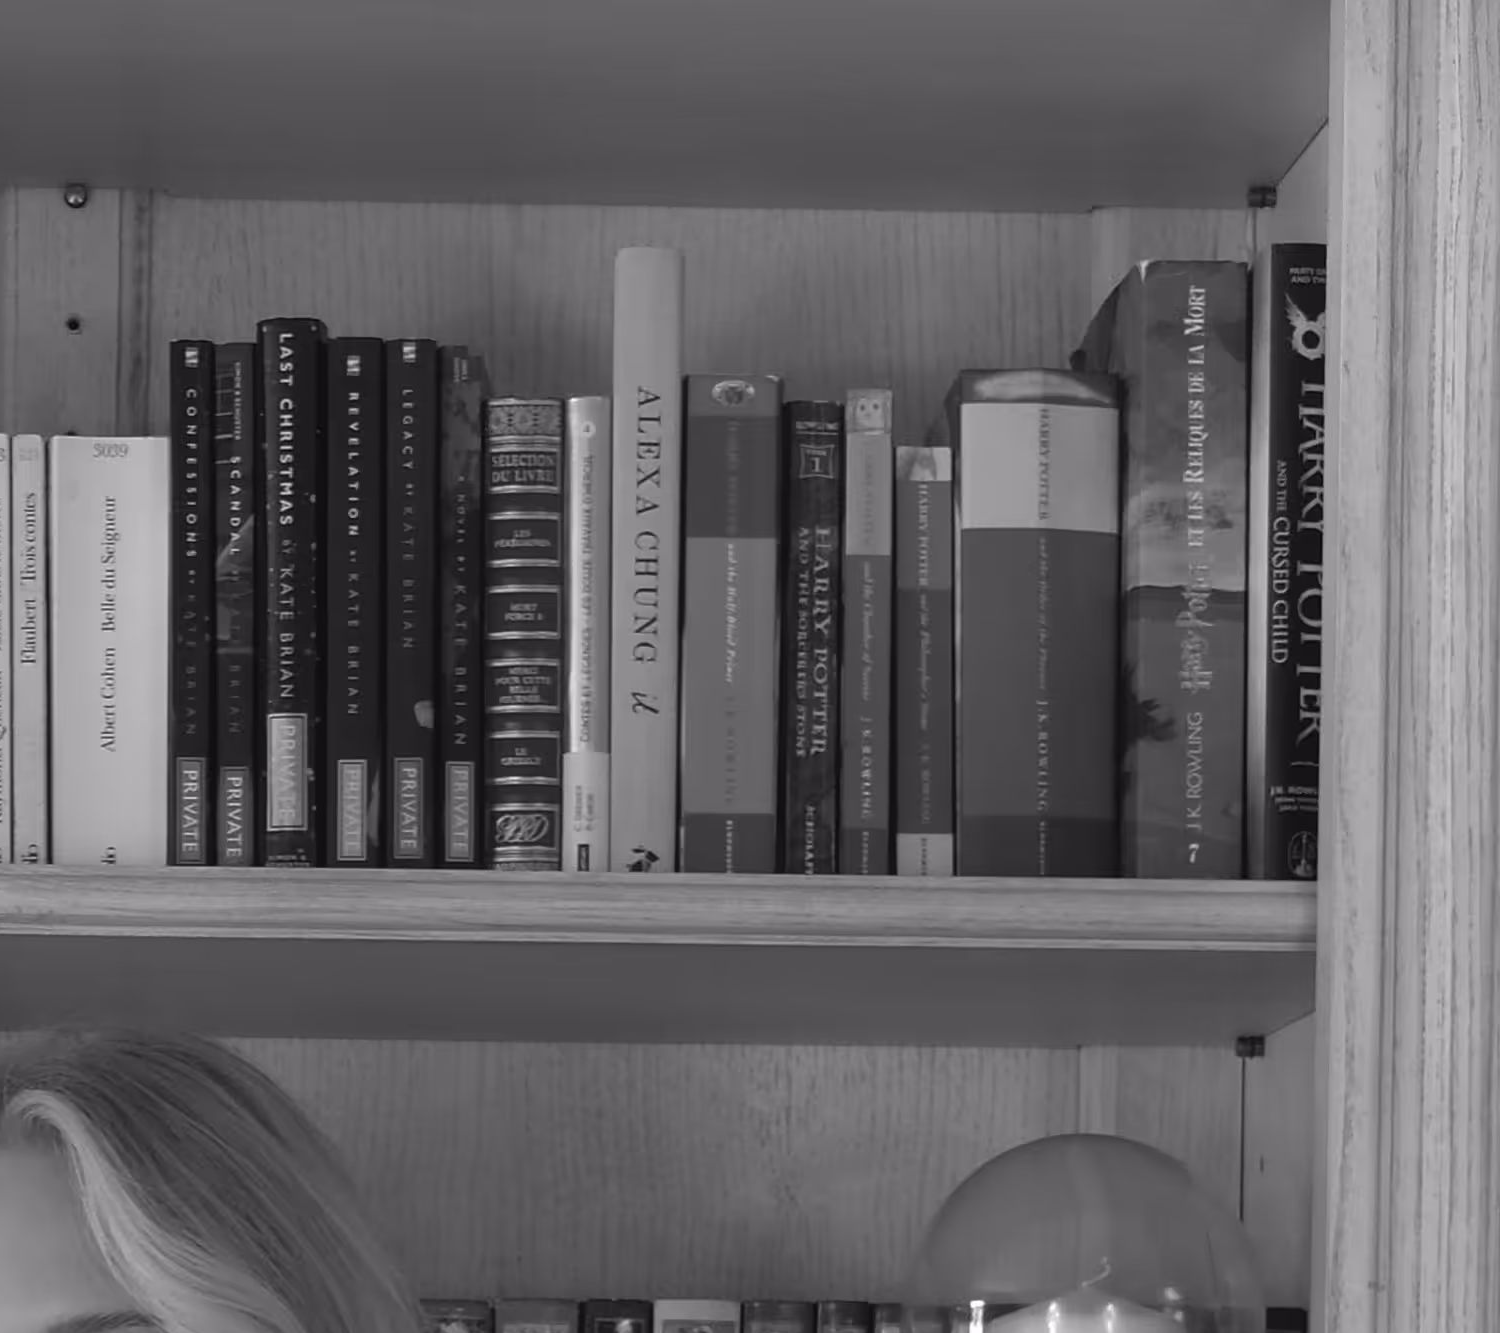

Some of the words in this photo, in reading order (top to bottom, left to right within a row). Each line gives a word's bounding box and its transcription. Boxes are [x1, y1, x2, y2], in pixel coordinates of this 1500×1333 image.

[279, 332, 294, 387] LAST
[1188, 344, 1205, 365] LA
[1188, 371, 1205, 393] DE
[279, 397, 294, 527] CHRISTMAS
[402, 388, 415, 472] LEGACY
[634, 385, 661, 516] ALEXA
[1039, 408, 1051, 456] HARRY
[1297, 381, 1326, 534] HARRY
[184, 388, 198, 558] CONFESSIONS
[347, 391, 360, 536] REVELATION
[1039, 461, 1051, 520] POTTER
[1277, 460, 1288, 487] AND
[19, 491, 37, 543] contes
[100, 495, 121, 565] Seigneur
[229, 456, 242, 557] SCANDAL
[402, 506, 415, 561] KATE
[918, 484, 930, 530] HARRY
[1188, 490, 1205, 519] LES
[1276, 489, 1287, 513] THE
[19, 545, 37, 587] Trois
[797, 526, 810, 564] AND
[918, 536, 930, 587] POTTER
[1270, 516, 1290, 594] CURSED
[100, 568, 117, 590] du
[279, 567, 294, 621] KATE
[347, 572, 360, 627] KATE
[634, 530, 661, 664] CHUNG
[797, 570, 810, 610] THE
[811, 525, 831, 638] HARRY
[19, 599, 37, 665] Flaubert
[100, 593, 117, 632] Belle
[402, 579, 415, 650] BRIAN
[455, 584, 468, 647] KATE
[1270, 599, 1290, 664] CHILD
[100, 646, 117, 700] Cohen
[279, 631, 294, 699] BRIAN
[347, 645, 360, 715] BRIAN
[1295, 561, 1323, 748] POTTER
[100, 704, 117, 752] Albert
[455, 666, 468, 746] BRIAN
[797, 703, 810, 758] STONE
[811, 647, 831, 757] POTTER
[278, 723, 296, 821] PRIVATE
[1186, 711, 1203, 799] ROWLING
[183, 768, 200, 854] PRIVATE
[225, 776, 242, 859] PRIVATE
[344, 768, 361, 852] PRIVATE
[400, 766, 417, 849] PRIVATE
[450, 767, 469, 851] PRIVATE
